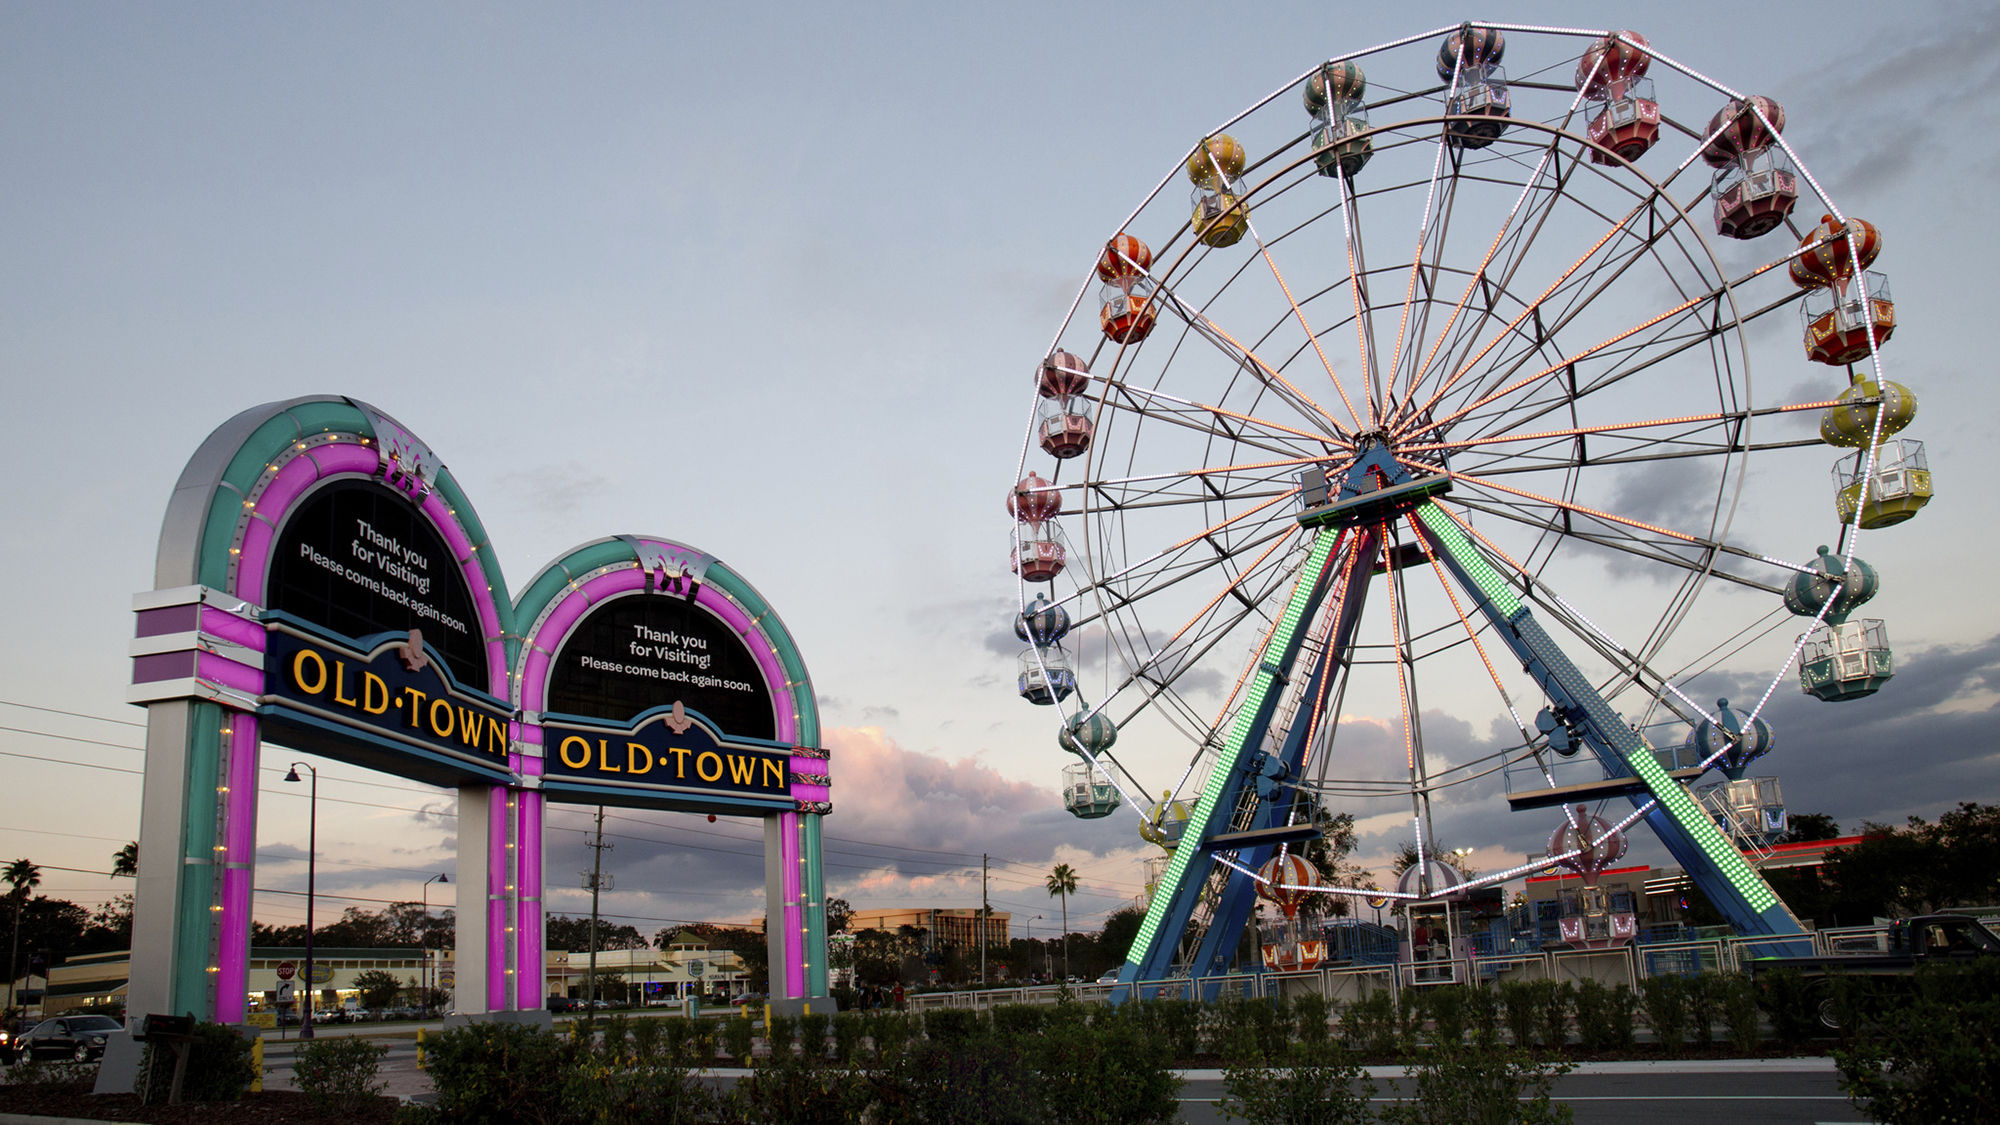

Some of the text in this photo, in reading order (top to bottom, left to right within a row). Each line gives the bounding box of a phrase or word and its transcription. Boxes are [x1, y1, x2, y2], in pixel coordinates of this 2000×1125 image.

[357, 518, 428, 570] Thank you
[352, 539, 431, 595] for Visiting!
[300, 543, 468, 635] Please come back again soon.
[629, 641, 712, 670] for Visiting!
[633, 624, 707, 650] Thank you
[581, 655, 754, 693] Please come back again soon.
[278, 967, 294, 975] STOP
